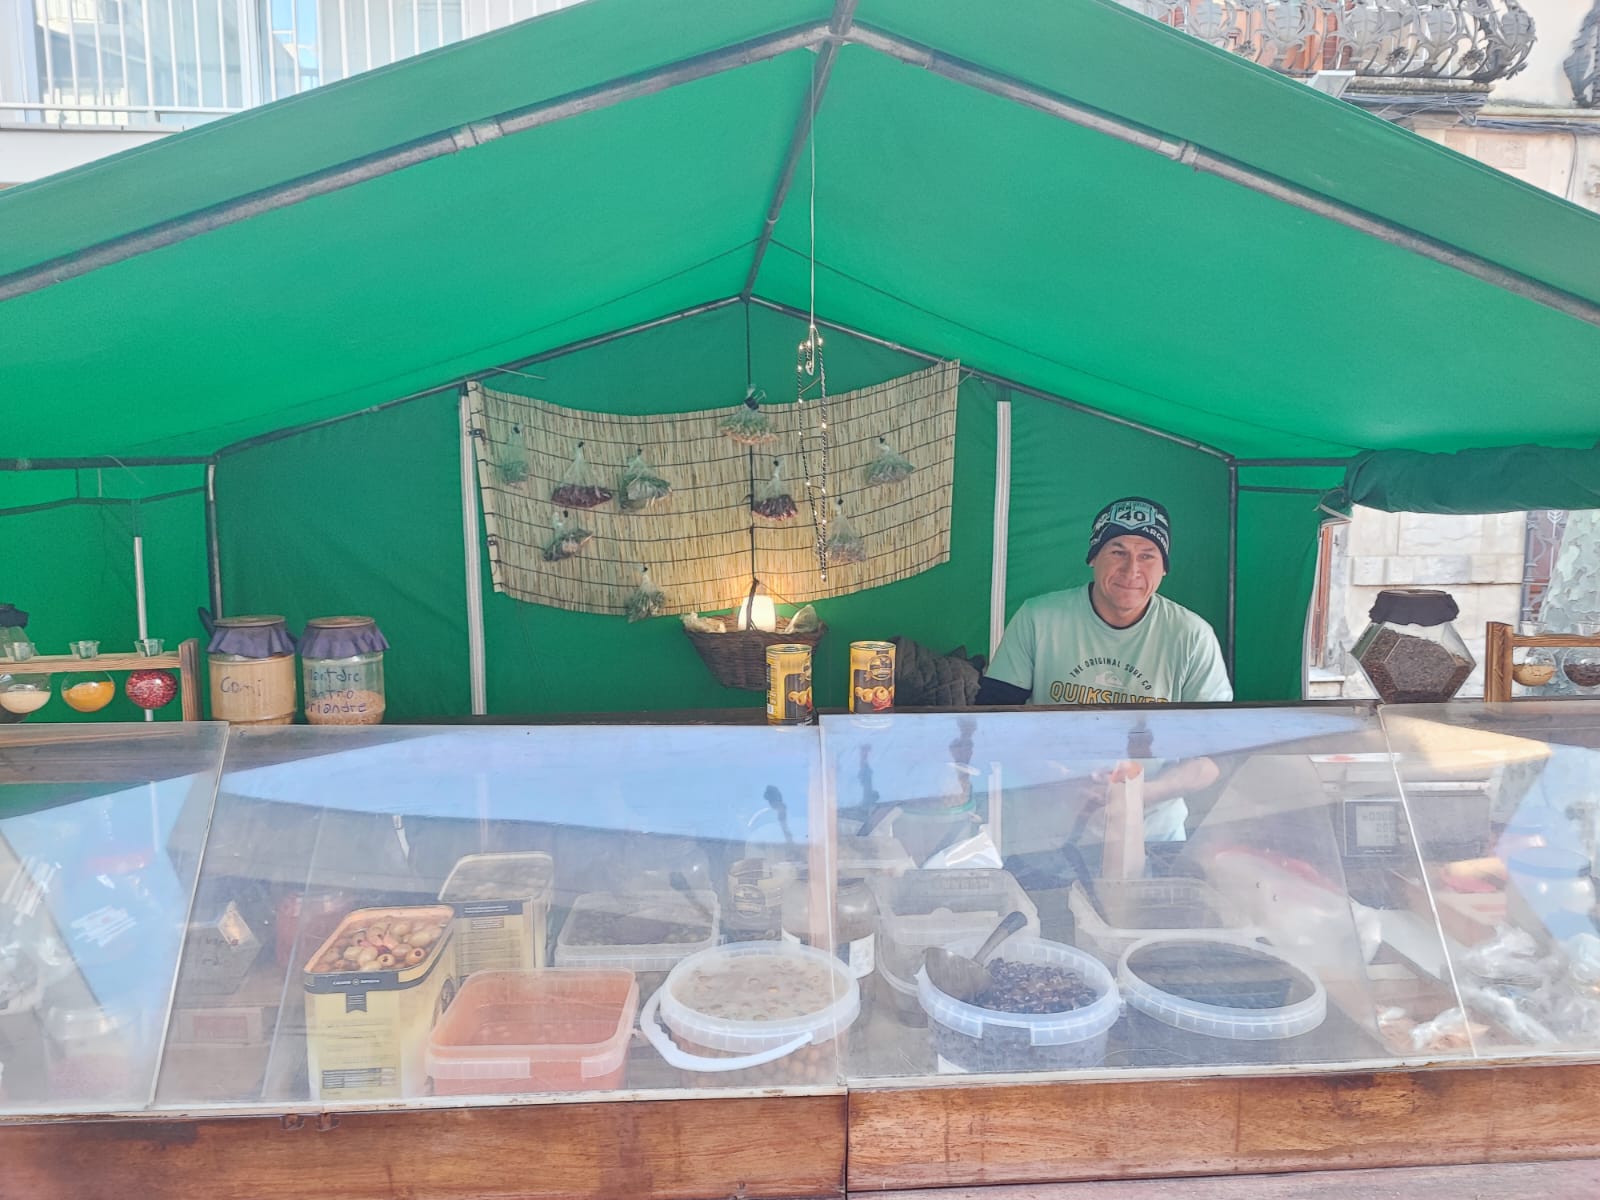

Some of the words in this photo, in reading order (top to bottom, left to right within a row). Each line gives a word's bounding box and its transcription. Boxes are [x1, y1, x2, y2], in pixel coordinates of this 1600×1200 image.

[1118, 510, 1146, 522] 40
[1069, 665, 1084, 678] THE
[1084, 657, 1121, 668] ORIGINAL
[1124, 663, 1143, 679] SURF
[1050, 680, 1169, 705] QUIKSIL
